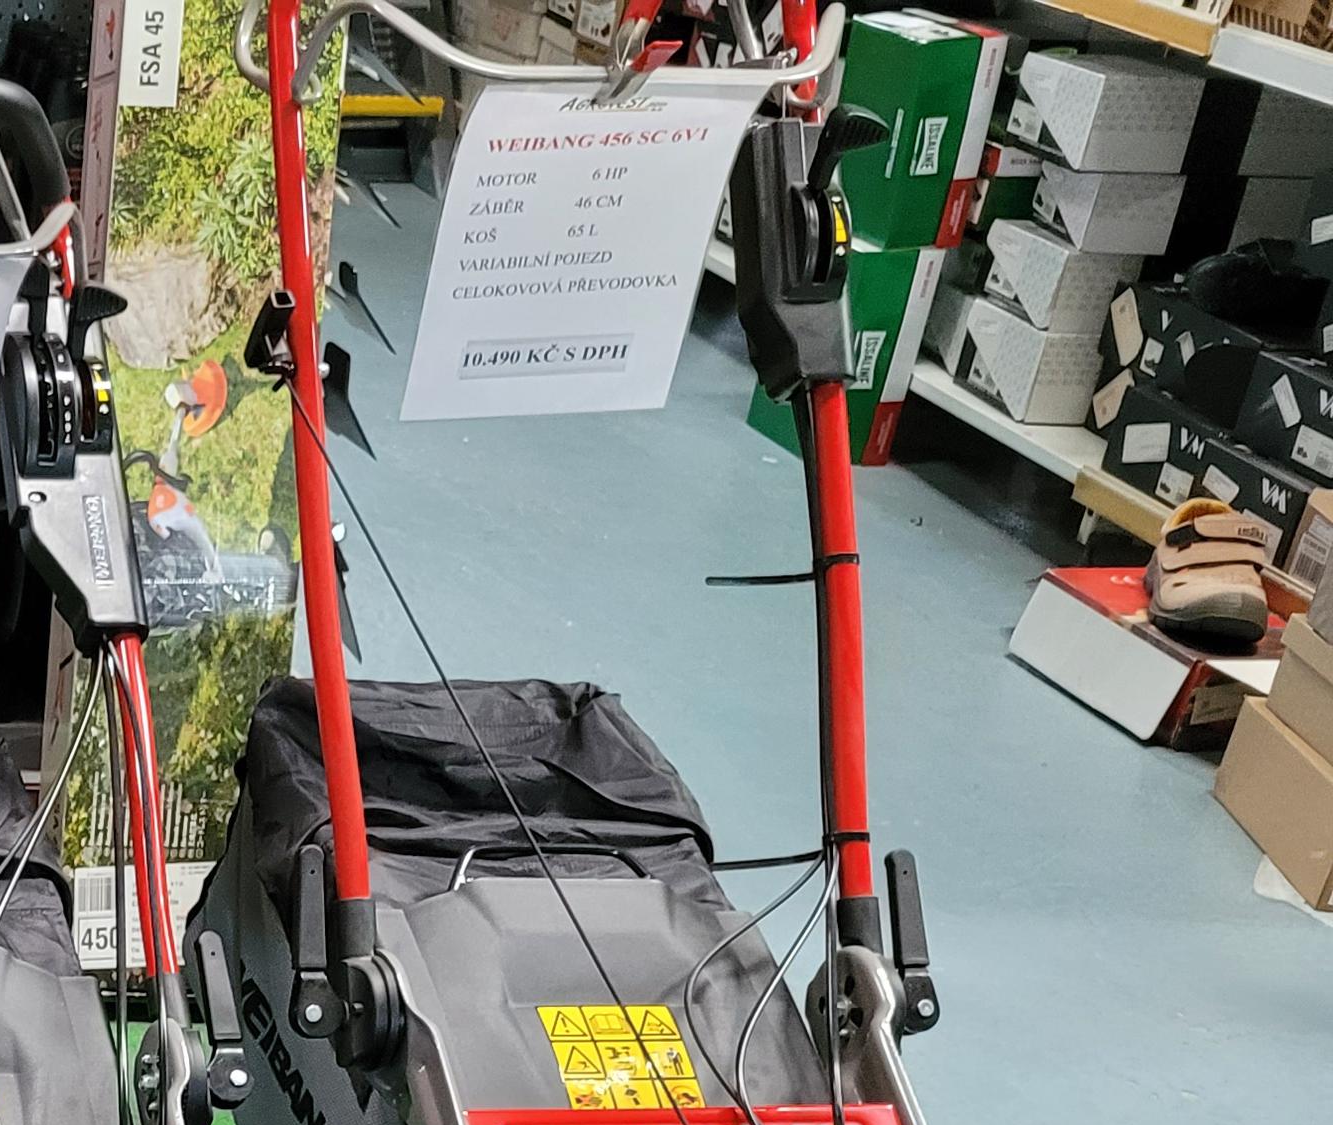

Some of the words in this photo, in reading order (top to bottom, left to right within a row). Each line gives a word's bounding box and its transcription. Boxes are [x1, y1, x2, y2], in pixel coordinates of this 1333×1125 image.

[147, 10, 165, 38] 45
[141, 51, 160, 88] FSA
[488, 133, 594, 154] WEIBANG
[599, 131, 632, 148] 456
[637, 130, 667, 146] SC
[671, 127, 709, 143] 6V1
[476, 171, 537, 188] MOTOR
[592, 168, 601, 181] 6
[604, 167, 628, 181] HP
[469, 199, 525, 216] ZÁBĚR
[574, 196, 592, 209] 46
[596, 195, 623, 208] CM
[463, 227, 497, 245] KOŠ
[567, 224, 585, 238] 65
[588, 224, 599, 237] L
[459, 253, 552, 272] VARIABILNÍ
[553, 250, 613, 268] POJEZD
[452, 281, 563, 301] CELOKOVOVÁ
[567, 274, 678, 293] PŘEVODOVKA
[462, 350, 521, 369] 10.490
[526, 344, 559, 365] KČ
[563, 347, 575, 363] S
[581, 344, 628, 362] DPH
